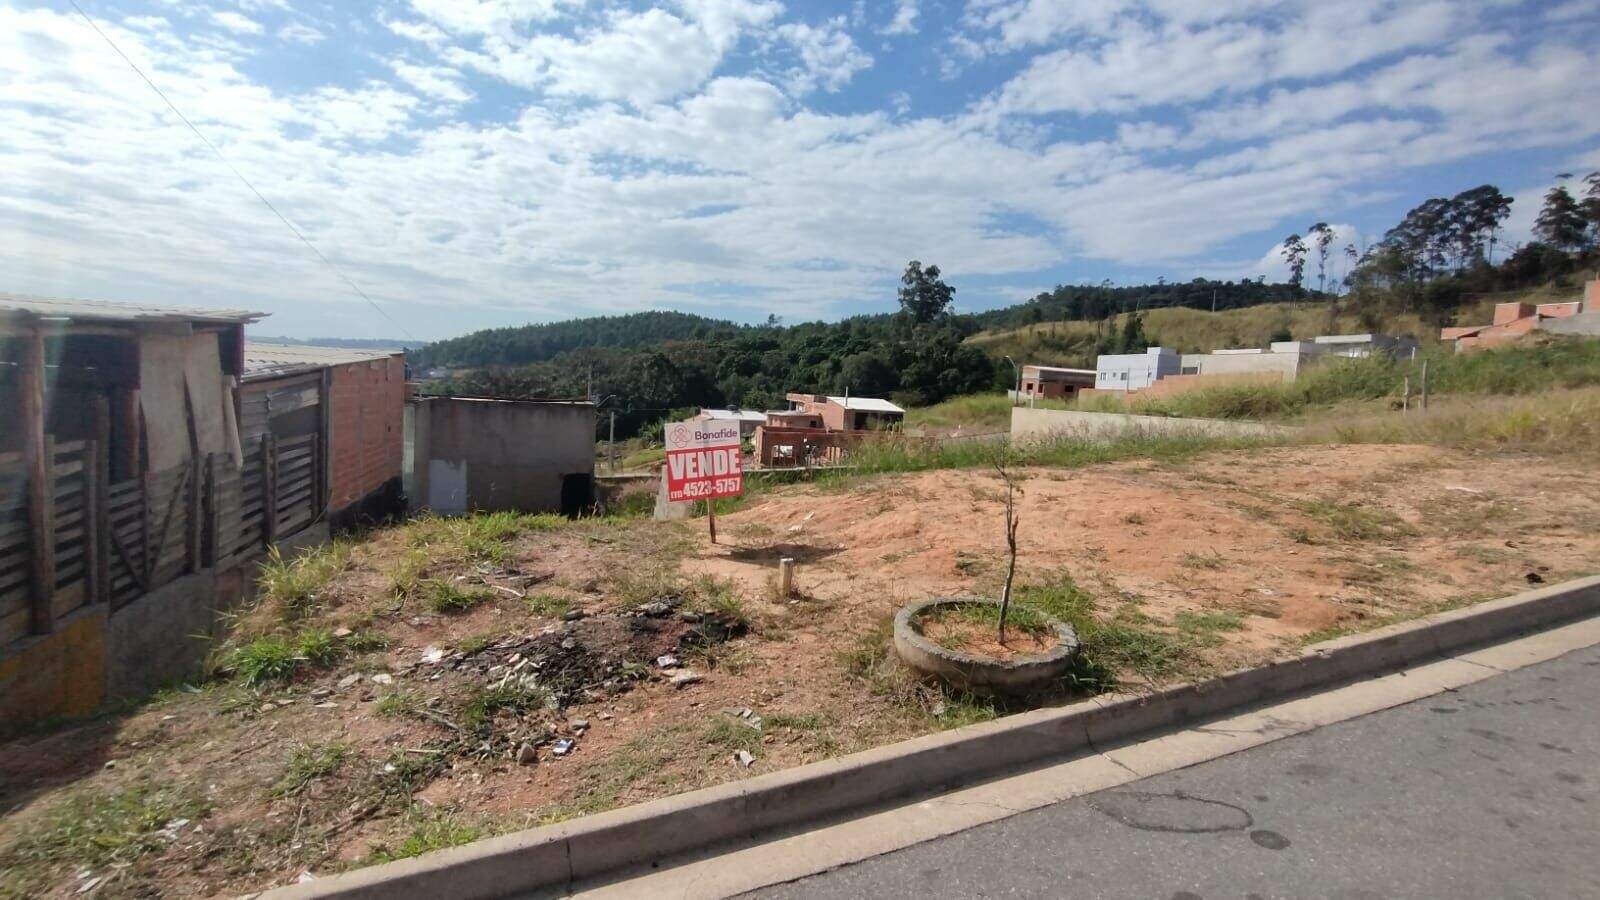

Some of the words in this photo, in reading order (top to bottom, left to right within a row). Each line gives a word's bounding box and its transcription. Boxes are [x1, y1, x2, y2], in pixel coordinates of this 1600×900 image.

[695, 429, 737, 440] Bonafide
[668, 448, 741, 480] VENDE
[683, 477, 741, 497] 4523-5757
